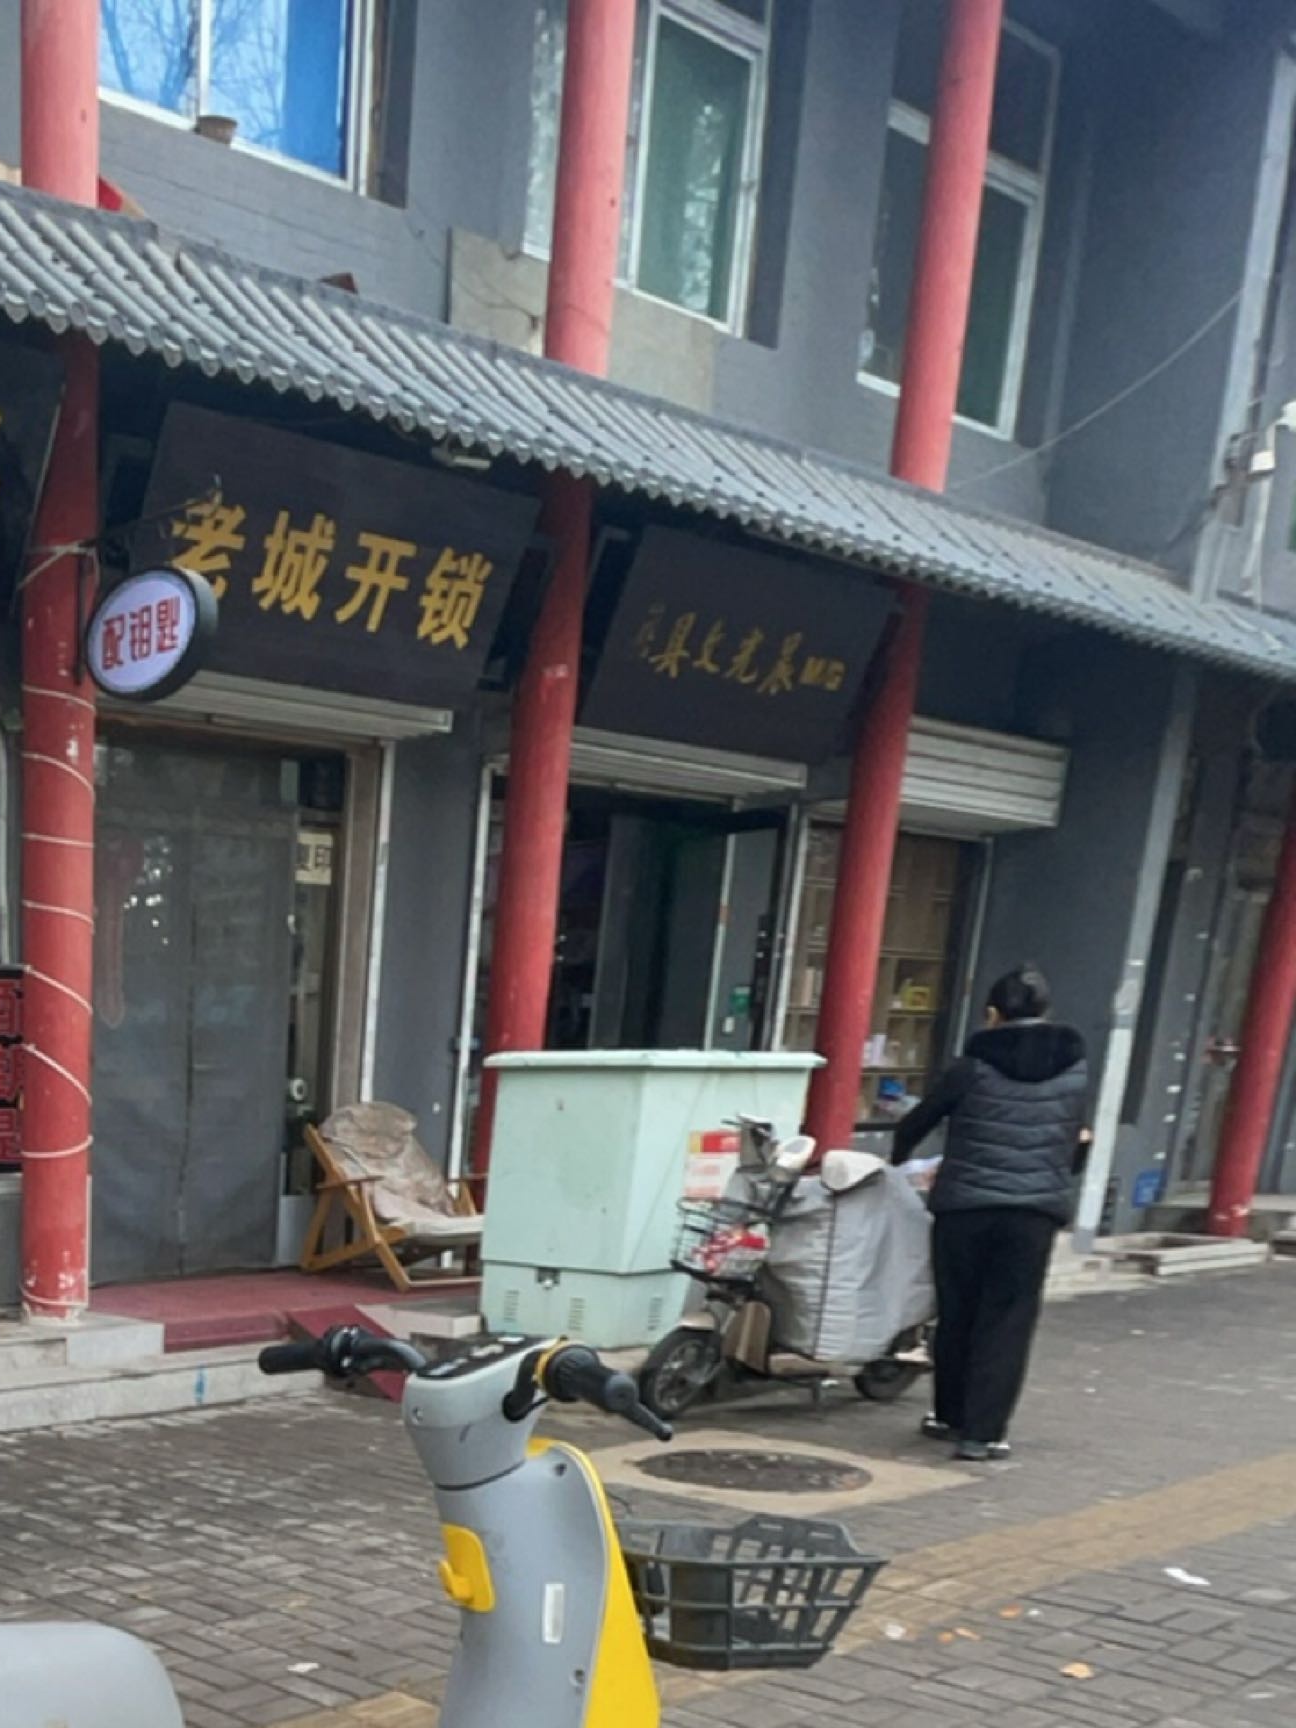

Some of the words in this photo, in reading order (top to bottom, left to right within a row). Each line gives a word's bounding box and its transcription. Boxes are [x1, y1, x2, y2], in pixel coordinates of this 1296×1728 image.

[171, 502, 493, 649] 老城开锁
[102, 597, 180, 670] 配钥匙
